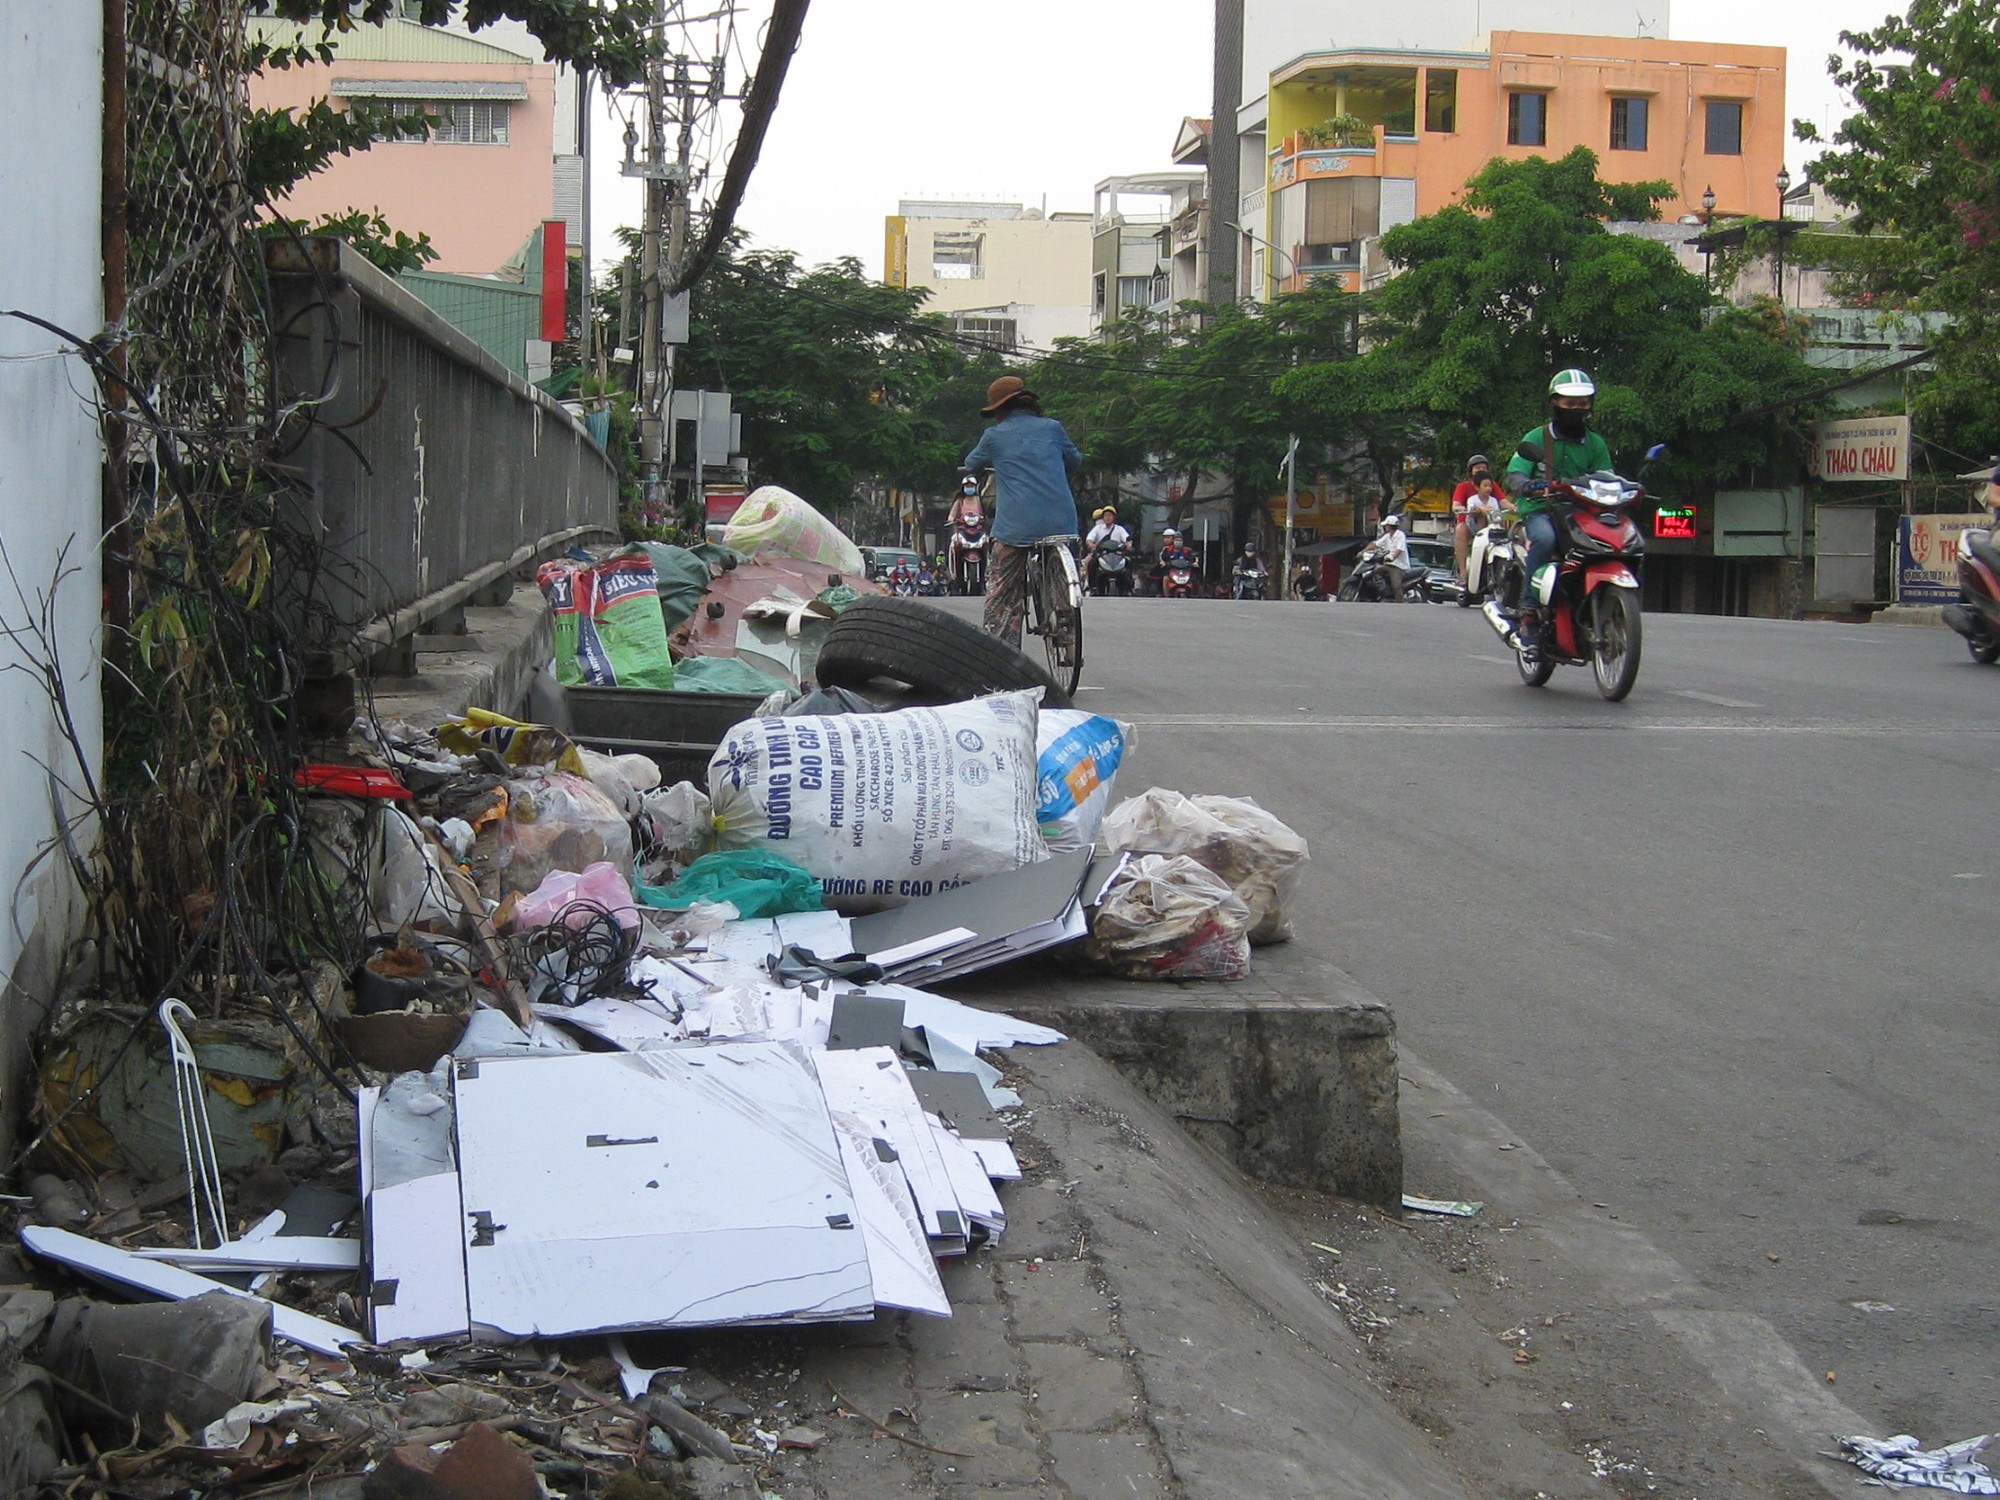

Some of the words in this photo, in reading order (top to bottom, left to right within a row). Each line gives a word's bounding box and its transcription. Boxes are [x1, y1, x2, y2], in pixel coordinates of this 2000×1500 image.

[1825, 440, 1857, 474] THẢO
[1861, 441, 1896, 473] CHÂU
[827, 731, 845, 766] REFINED
[799, 755, 823, 791] CAO
[869, 749, 881, 811] SACCHAROSE
[901, 769, 912, 784] Sản
[829, 769, 845, 829] PREMIUM
[883, 777, 895, 807] XNCB:
[945, 781, 955, 798] 3250
[879, 808, 894, 823] SỐ
[945, 800, 955, 816] 375
[850, 821, 865, 848] KHỐI
[914, 828, 925, 843] TY
[908, 842, 924, 866] CÔNG
[814, 876, 866, 895] ƯỜNG
[872, 880, 894, 895] RE
[900, 879, 933, 897] CAO
